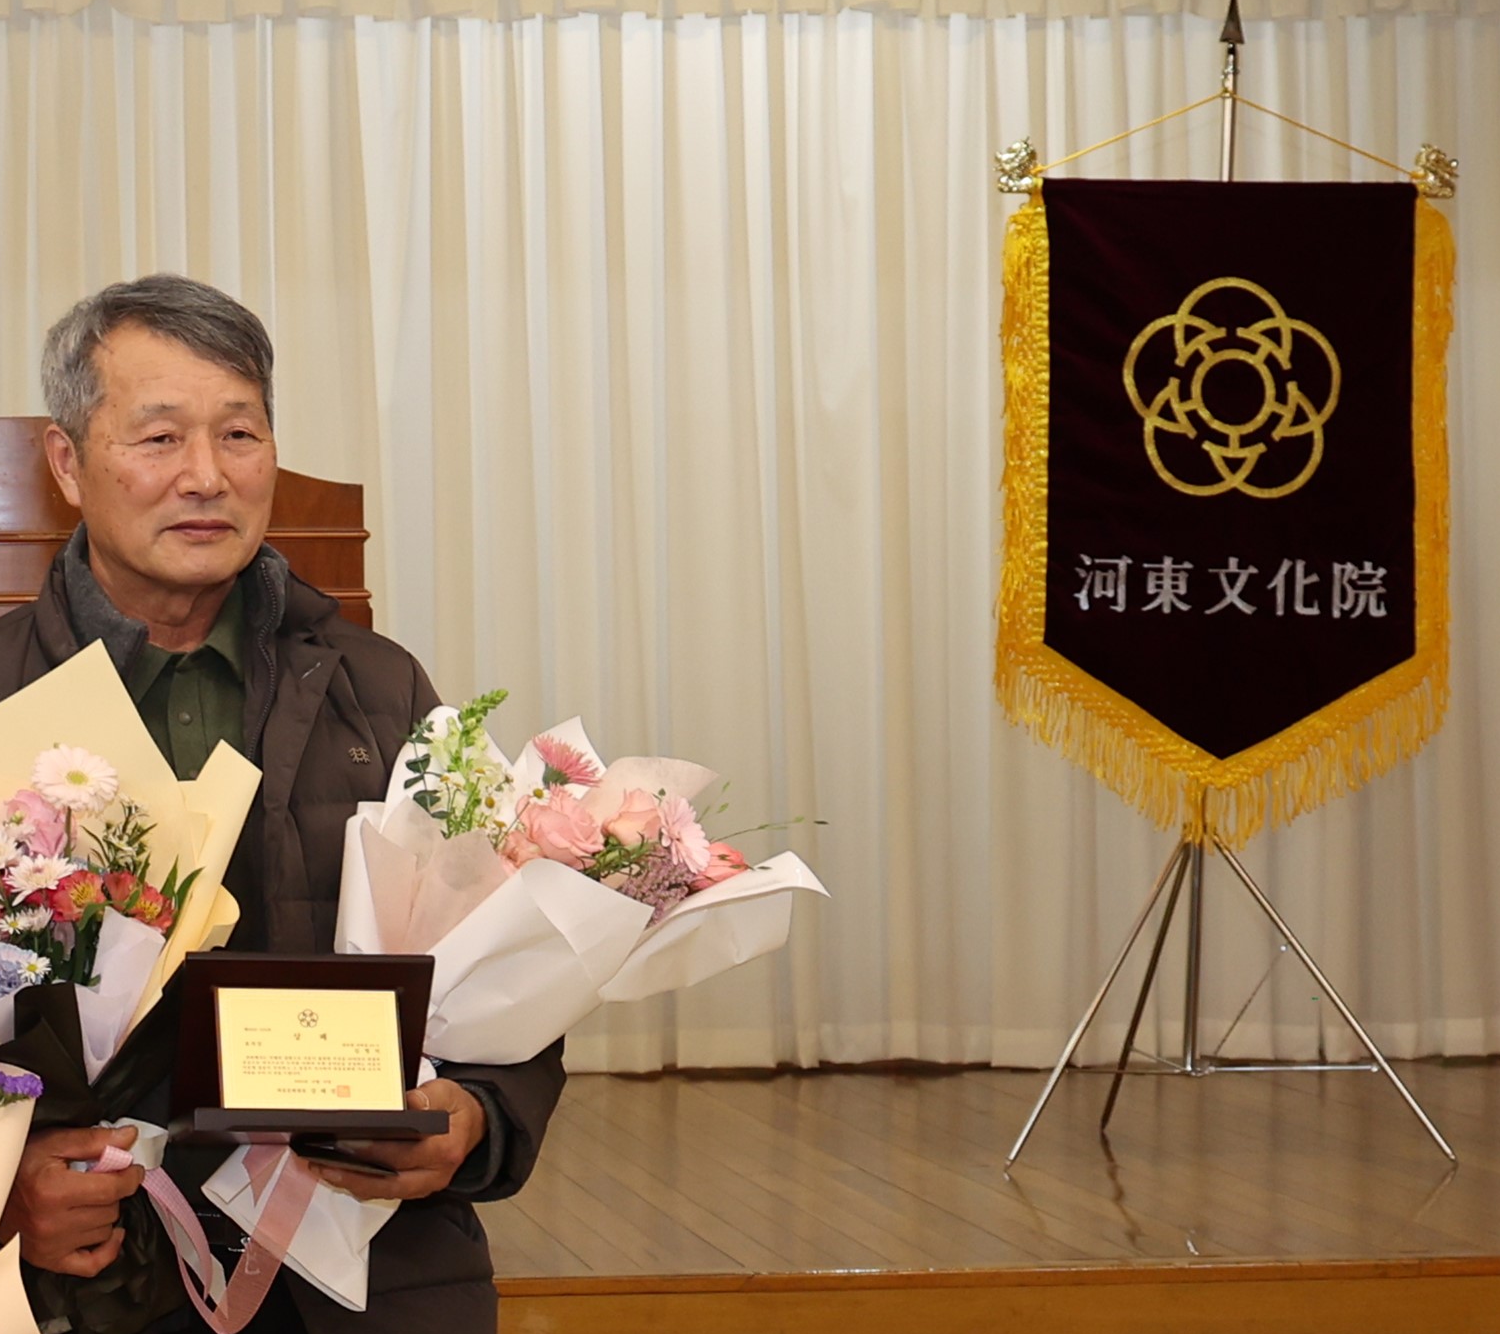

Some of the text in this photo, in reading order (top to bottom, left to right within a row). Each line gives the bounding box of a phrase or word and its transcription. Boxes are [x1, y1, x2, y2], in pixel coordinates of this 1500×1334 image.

[1073, 554, 1387, 619] 河東文化院
